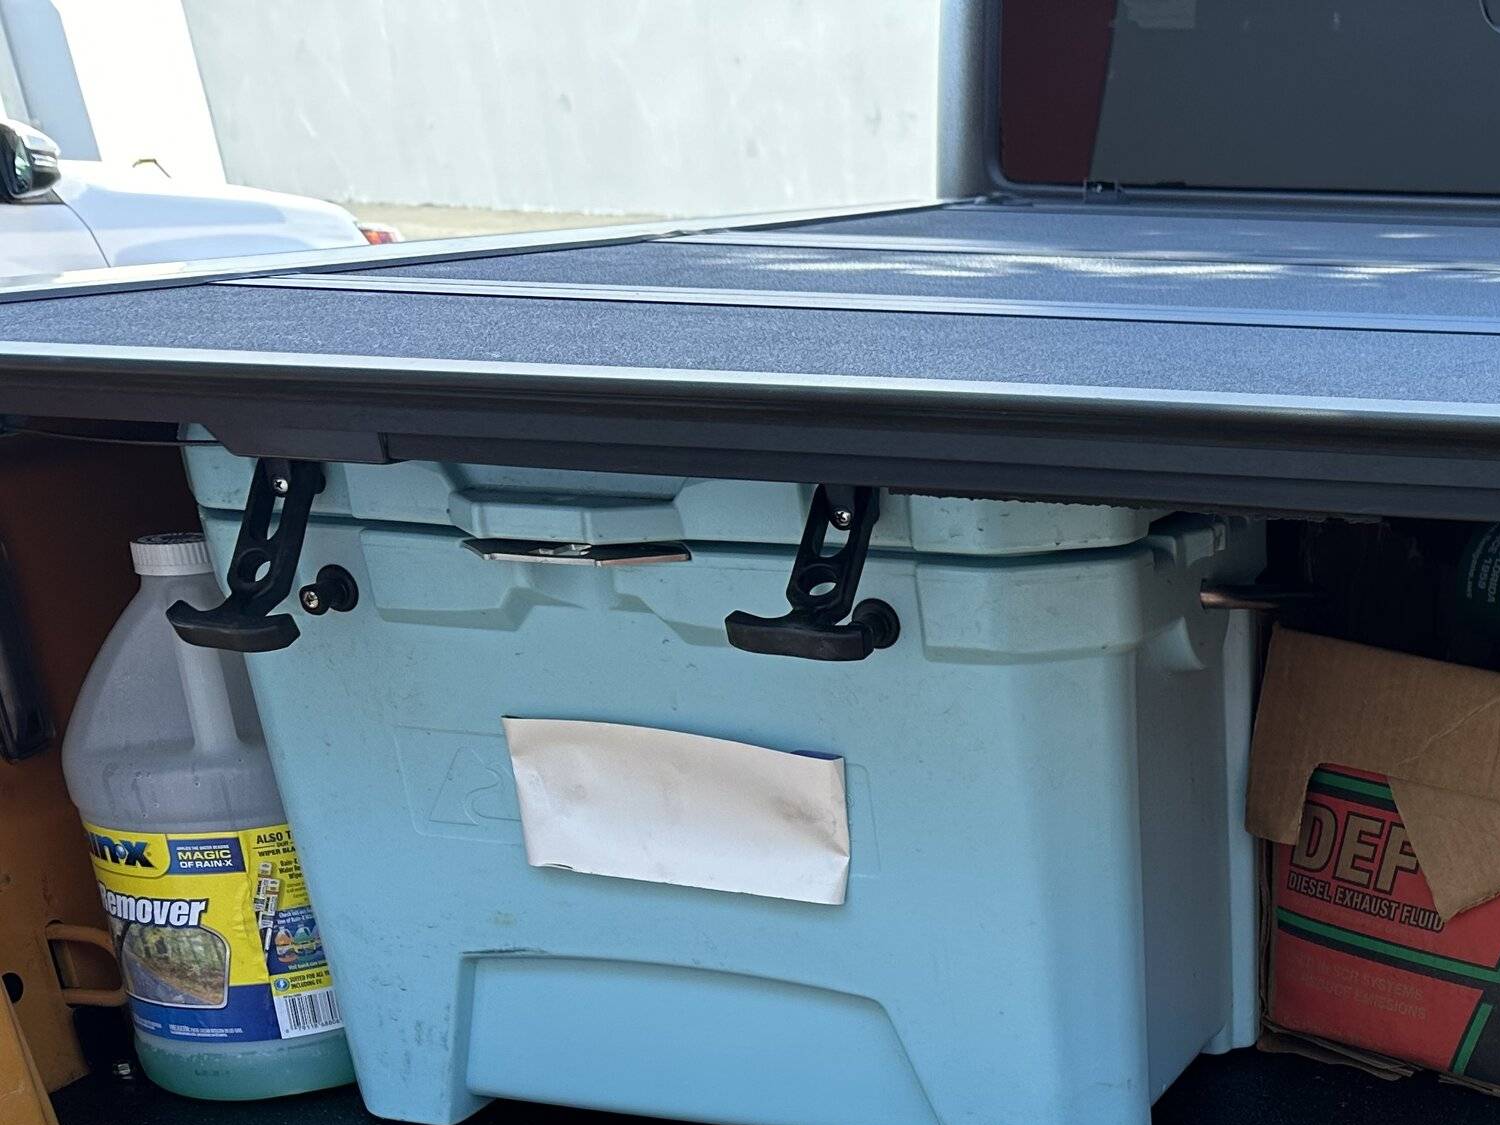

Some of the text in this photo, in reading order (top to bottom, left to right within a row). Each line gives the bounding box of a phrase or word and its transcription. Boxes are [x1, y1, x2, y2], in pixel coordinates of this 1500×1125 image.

[256, 832, 283, 844] ALSO
[258, 849, 280, 857] WIPER
[1290, 801, 1420, 895] DEF
[177, 849, 232, 860] MAGIC
[1288, 872, 1331, 903] DIESEL
[1335, 887, 1399, 921] EXHAUST
[1399, 903, 1445, 932] FLUID
